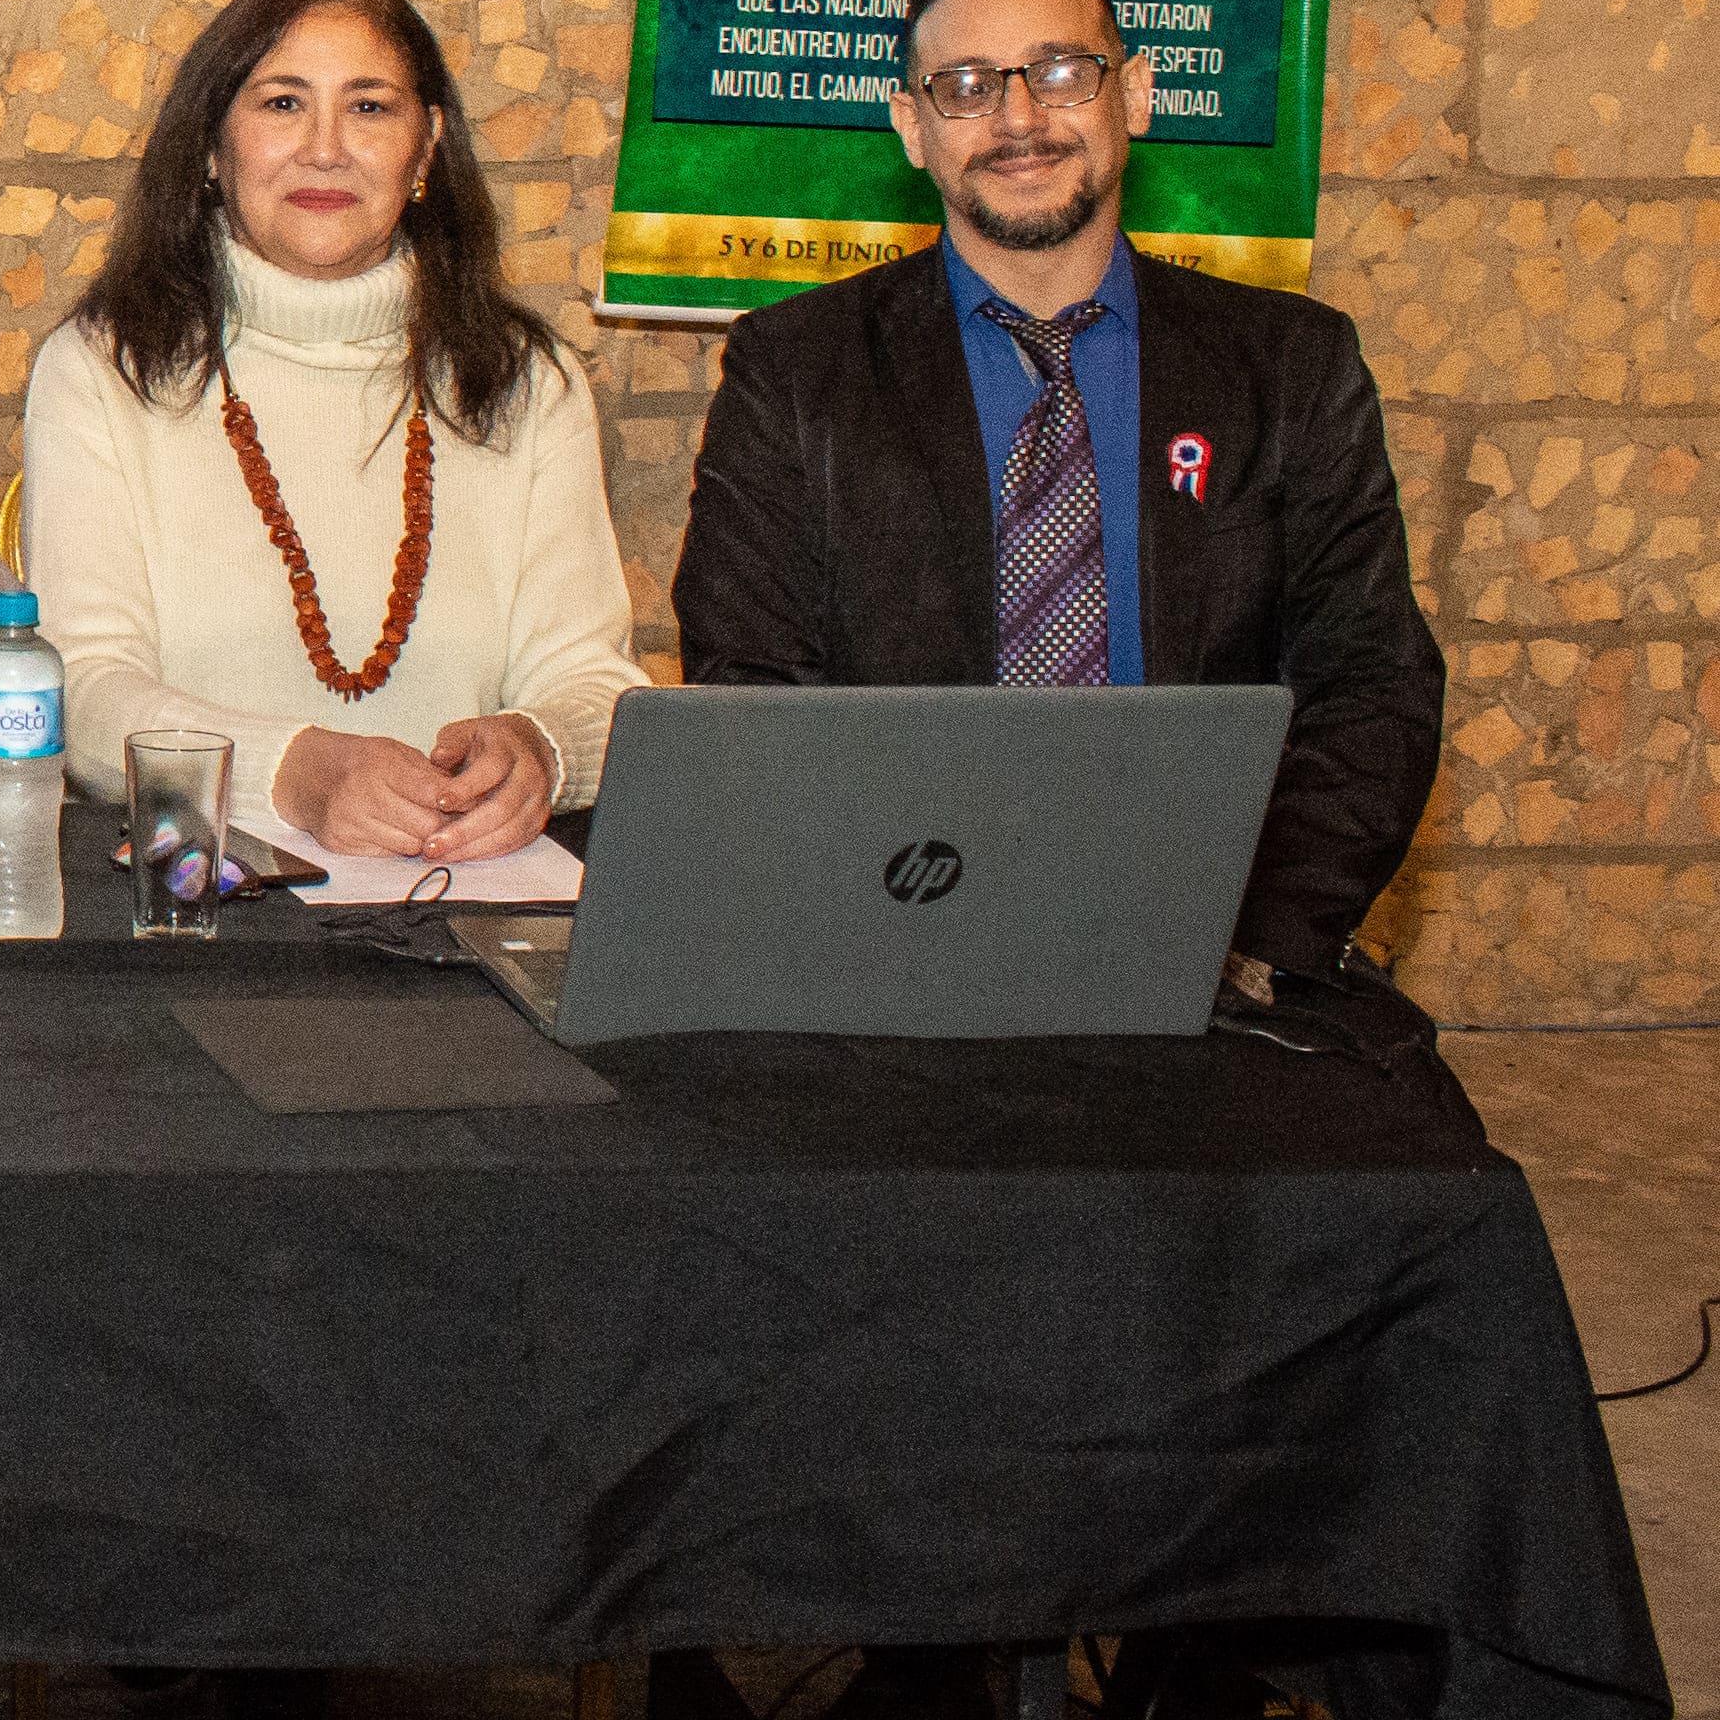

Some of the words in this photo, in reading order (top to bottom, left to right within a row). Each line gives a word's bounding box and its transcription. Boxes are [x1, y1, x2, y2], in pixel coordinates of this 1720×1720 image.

[1112, 1, 1212, 31] ENTARON
[718, 26, 851, 59] ENCUENTREN
[854, 33, 901, 65] HOY,
[711, 68, 785, 101] MUTUO,
[789, 72, 815, 101] EL
[718, 234, 735, 257] 5
[740, 238, 757, 258] Y
[762, 237, 779, 258] 6
[786, 239, 817, 260] DE
[827, 241, 904, 263] JUNIO
